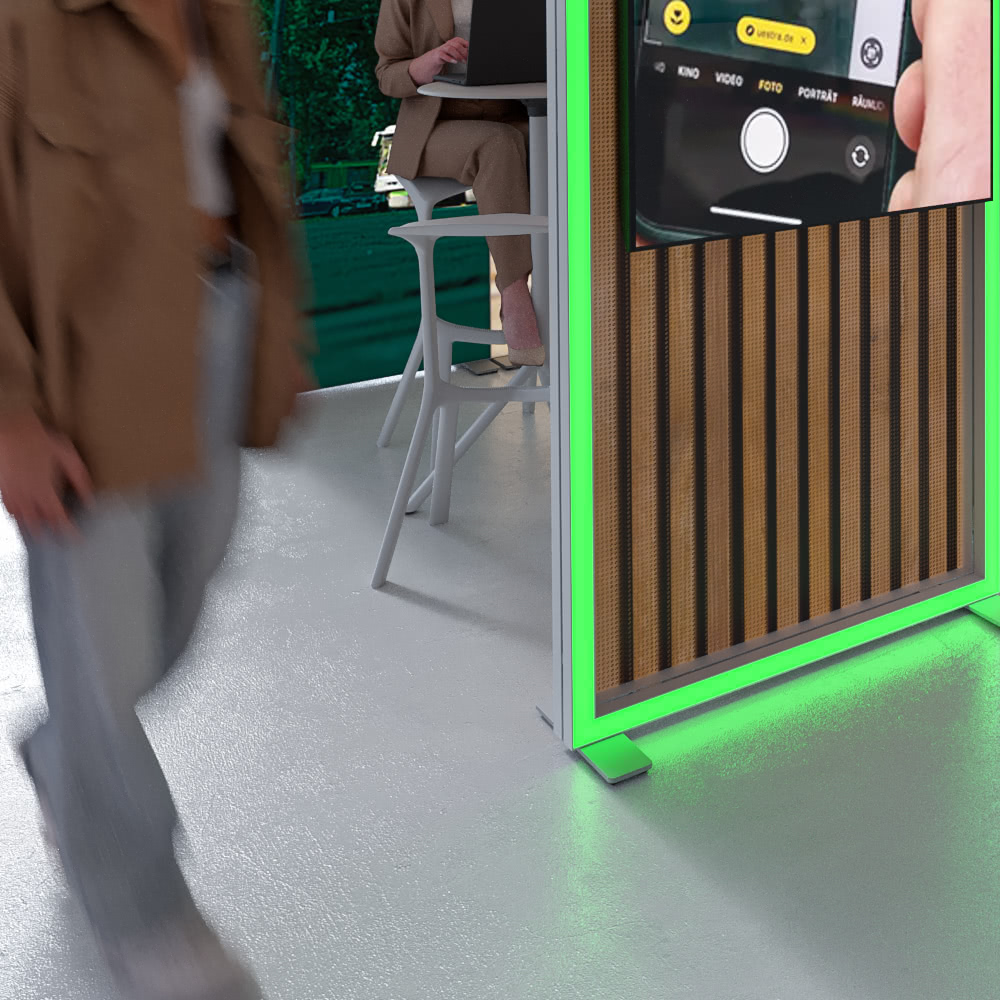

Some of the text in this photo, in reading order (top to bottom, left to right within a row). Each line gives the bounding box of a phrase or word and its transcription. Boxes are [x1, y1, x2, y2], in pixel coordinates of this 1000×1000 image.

[677, 65, 700, 80] KINO
[715, 72, 744, 88] VIDEO
[758, 79, 784, 94] FOTO
[798, 86, 838, 103] PORTRÄT
